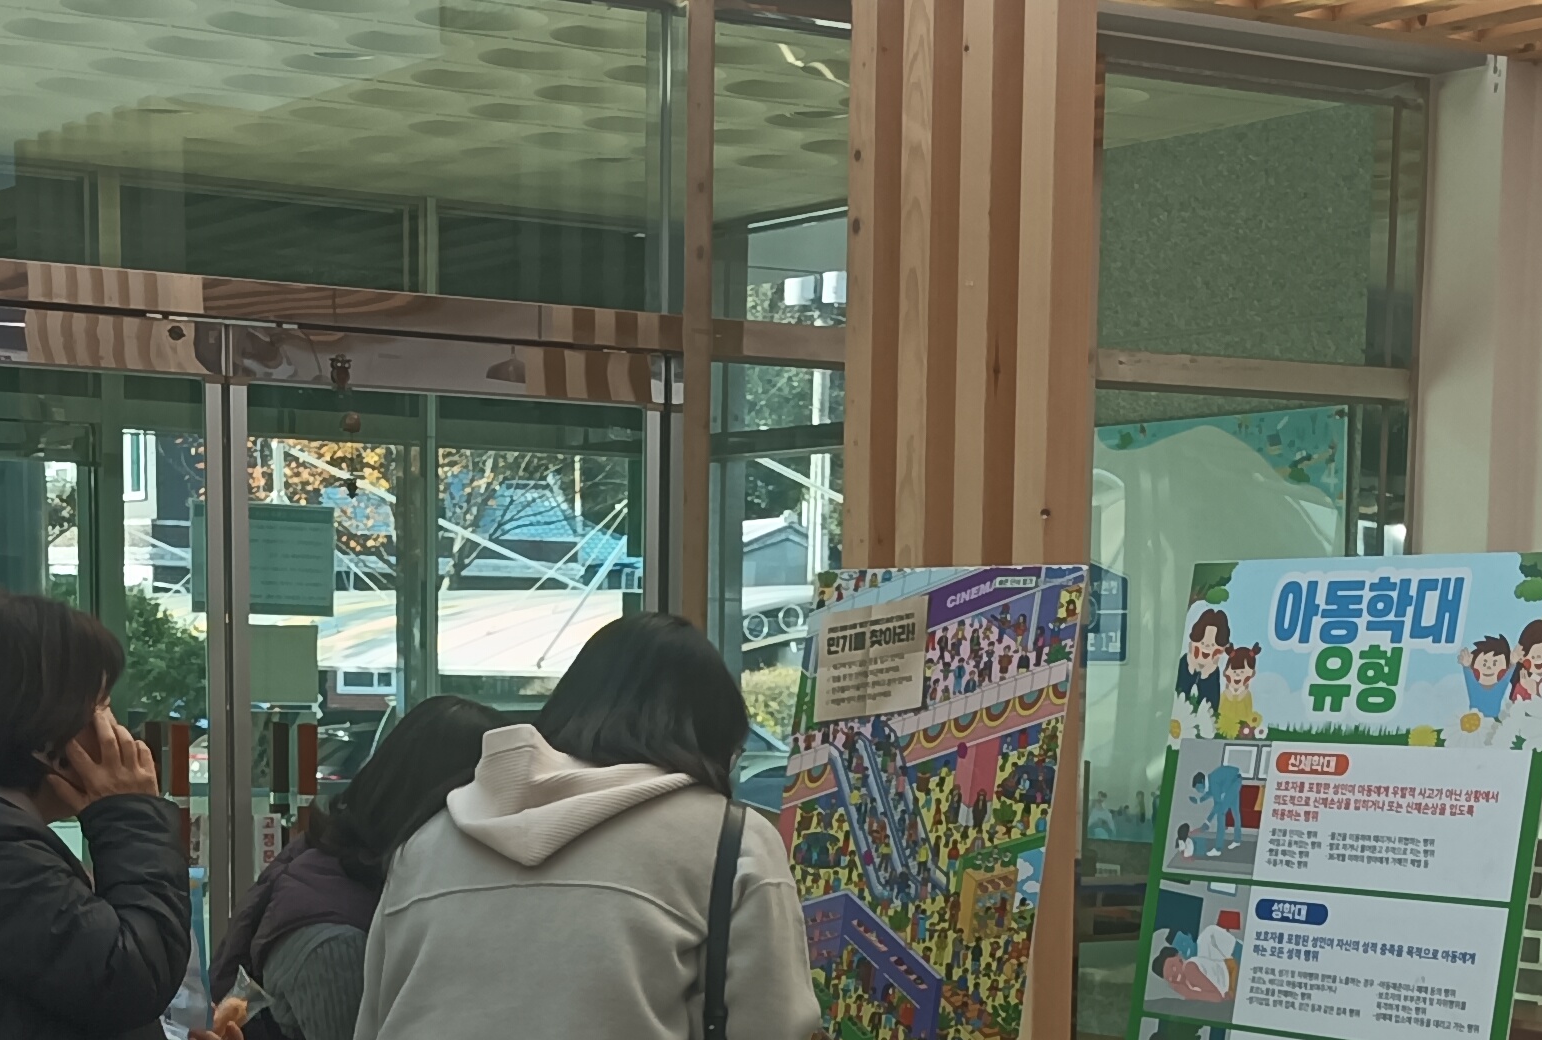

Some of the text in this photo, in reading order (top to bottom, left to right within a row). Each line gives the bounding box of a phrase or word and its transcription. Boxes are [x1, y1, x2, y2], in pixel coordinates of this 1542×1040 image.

[1274, 577, 1465, 644] 아동학대
[869, 622, 915, 648] 찾아라!
[1309, 644, 1403, 712] 유형
[1288, 756, 1336, 772] 신체학대
[1275, 781, 1305, 793] 보호자를
[1358, 784, 1389, 798] 아동에게
[1418, 786, 1443, 800] 사고가
[1445, 788, 1463, 802] 아닌
[1464, 789, 1499, 803] 상황에서
[1303, 811, 1318, 822] 행위
[1272, 902, 1307, 920] 성학대
[1255, 931, 1284, 944] 보호자를
[1362, 942, 1377, 954] 성적
[1269, 946, 1284, 958] 모든
[1304, 950, 1319, 962] 행위
